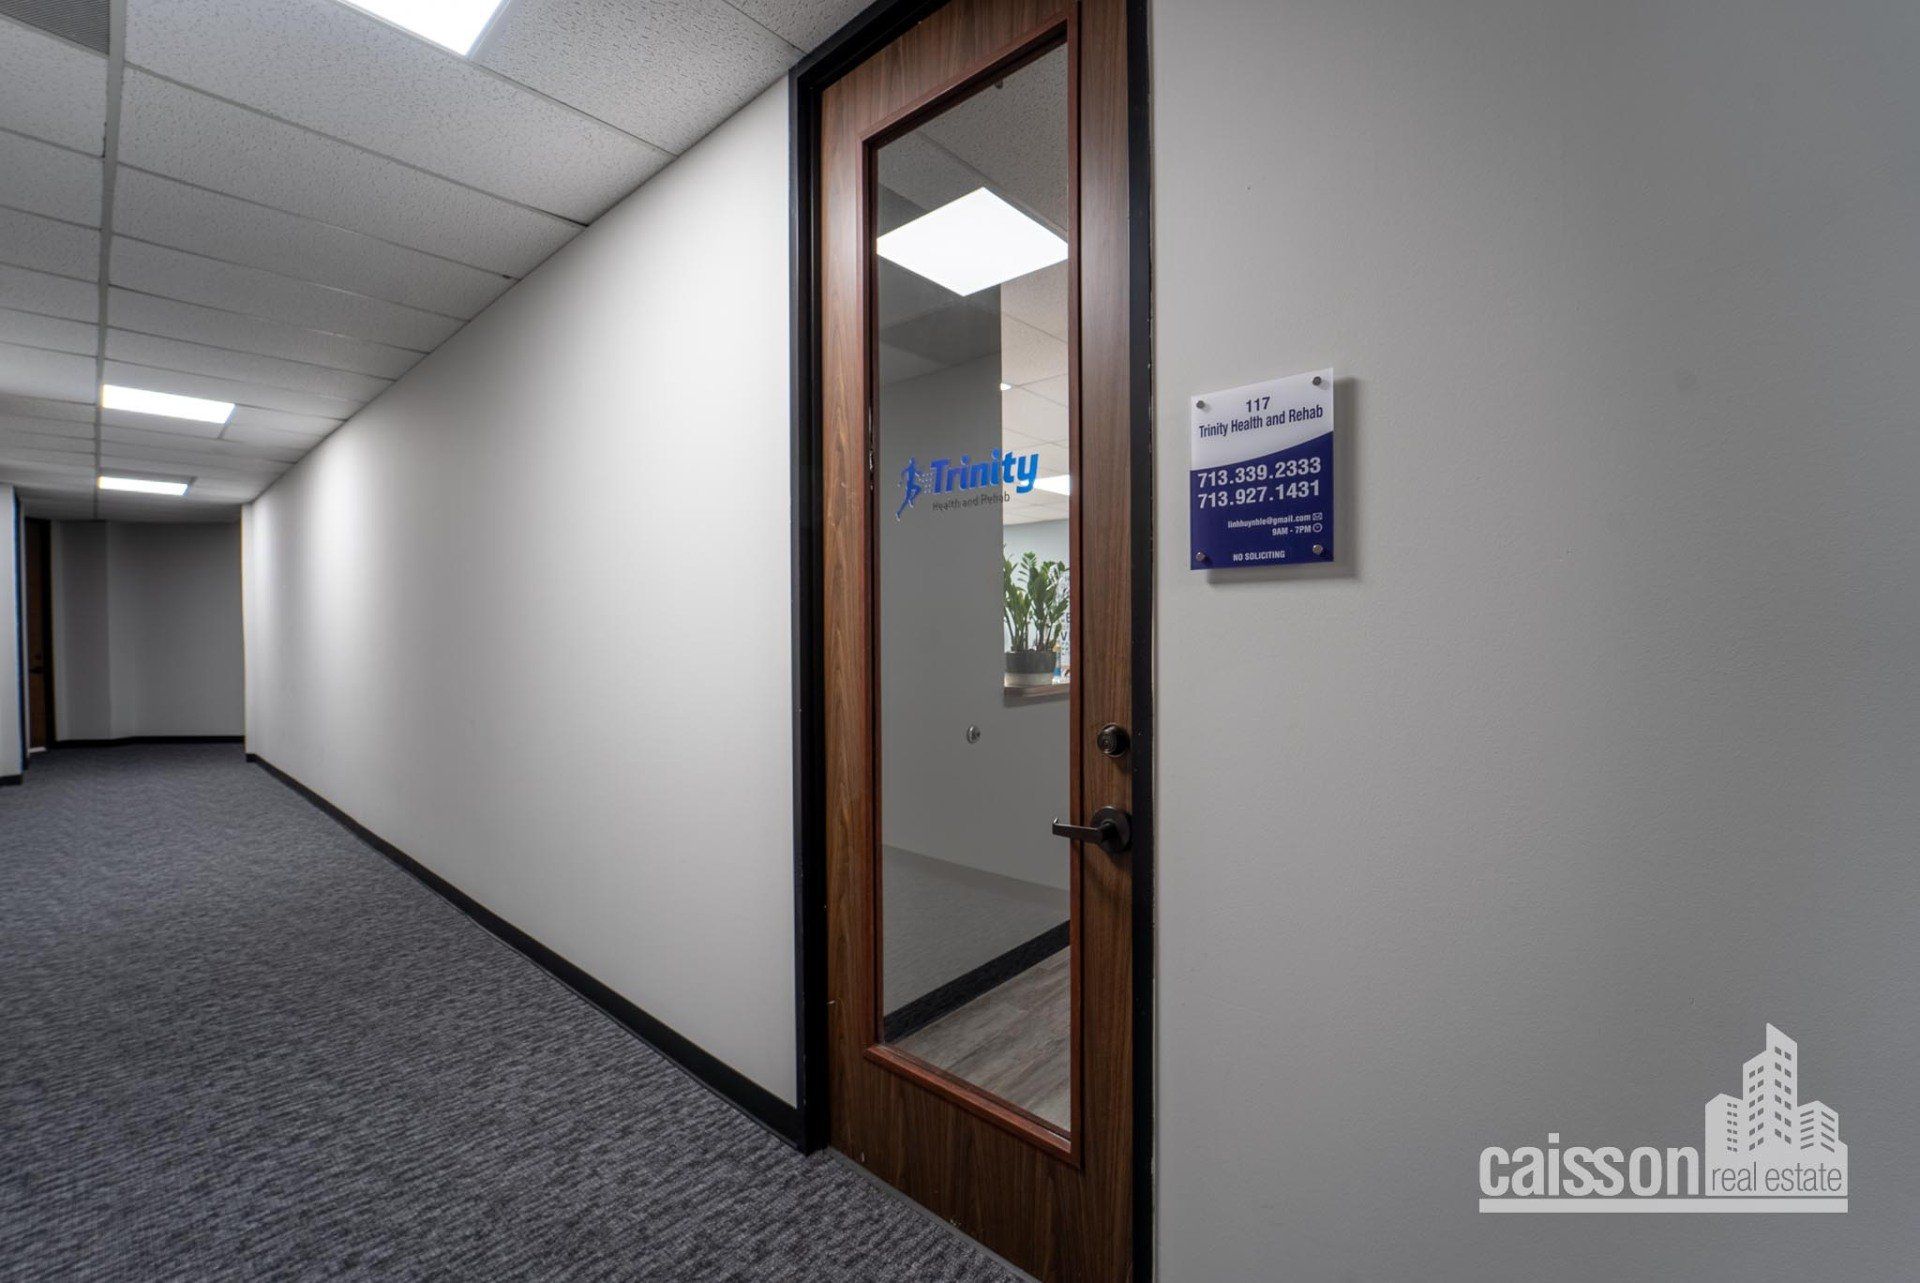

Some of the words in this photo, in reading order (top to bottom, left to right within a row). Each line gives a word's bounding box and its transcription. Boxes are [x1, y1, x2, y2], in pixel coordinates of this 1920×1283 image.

[1246, 396, 1271, 413] 117
[1199, 422, 1228, 438] Trinity
[1231, 415, 1263, 433] Health
[1266, 411, 1285, 427] and
[1288, 404, 1323, 423] Rehab
[930, 448, 1039, 494] Trinity
[1198, 456, 1321, 488] 713.339.2333
[932, 499, 961, 511] Health
[962, 496, 979, 507] and
[981, 491, 1010, 505] Rehab
[1198, 480, 1320, 509] 713.927.1431
[1272, 527, 1288, 536] 9AM
[1295, 525, 1312, 534] 7PM
[1233, 553, 1243, 561] NO
[1244, 550, 1285, 560] SOLICITING
